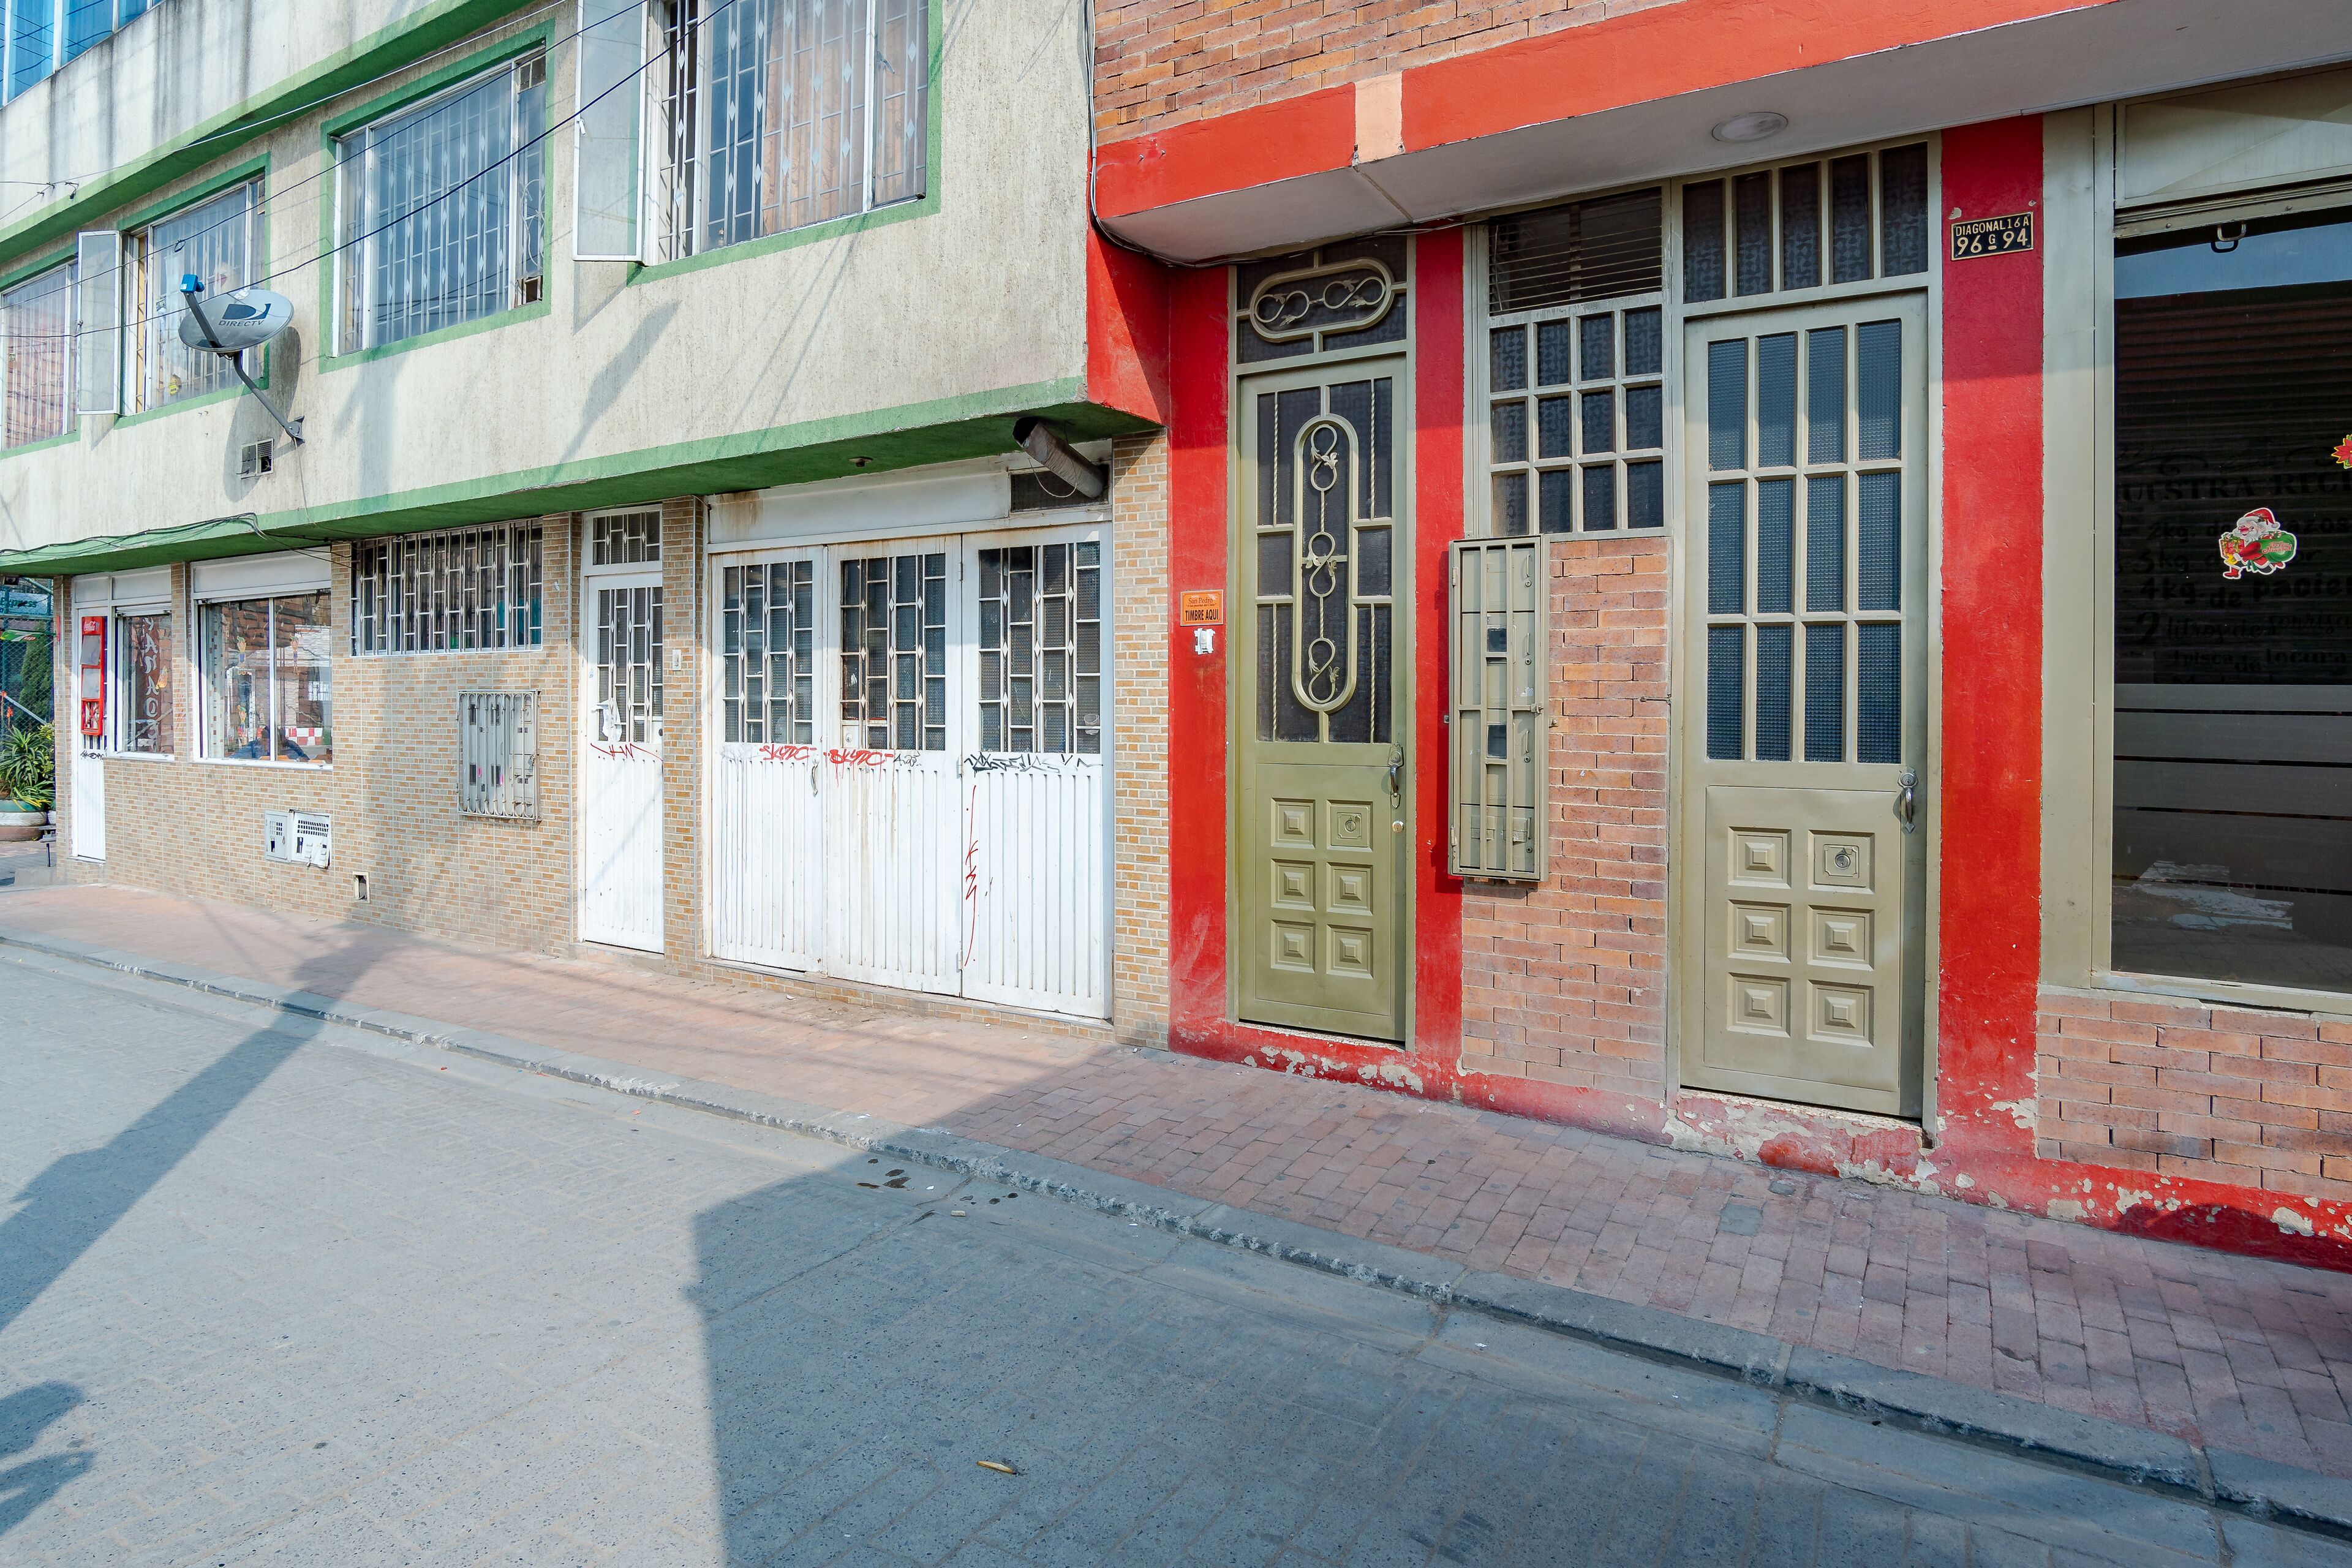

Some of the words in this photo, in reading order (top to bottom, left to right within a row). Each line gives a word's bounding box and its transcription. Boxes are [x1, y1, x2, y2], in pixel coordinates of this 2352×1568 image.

[1956, 220, 2005, 236] DIAGONAL
[2007, 217, 2020, 229] 16
[2023, 216, 2029, 227] A
[1957, 235, 1982, 255] 96
[2003, 228, 2028, 249] 94
[2261, 543, 2293, 554] Navidad
[1185, 609, 1204, 621] TIMBRE
[1205, 609, 1219, 620] AQUI
